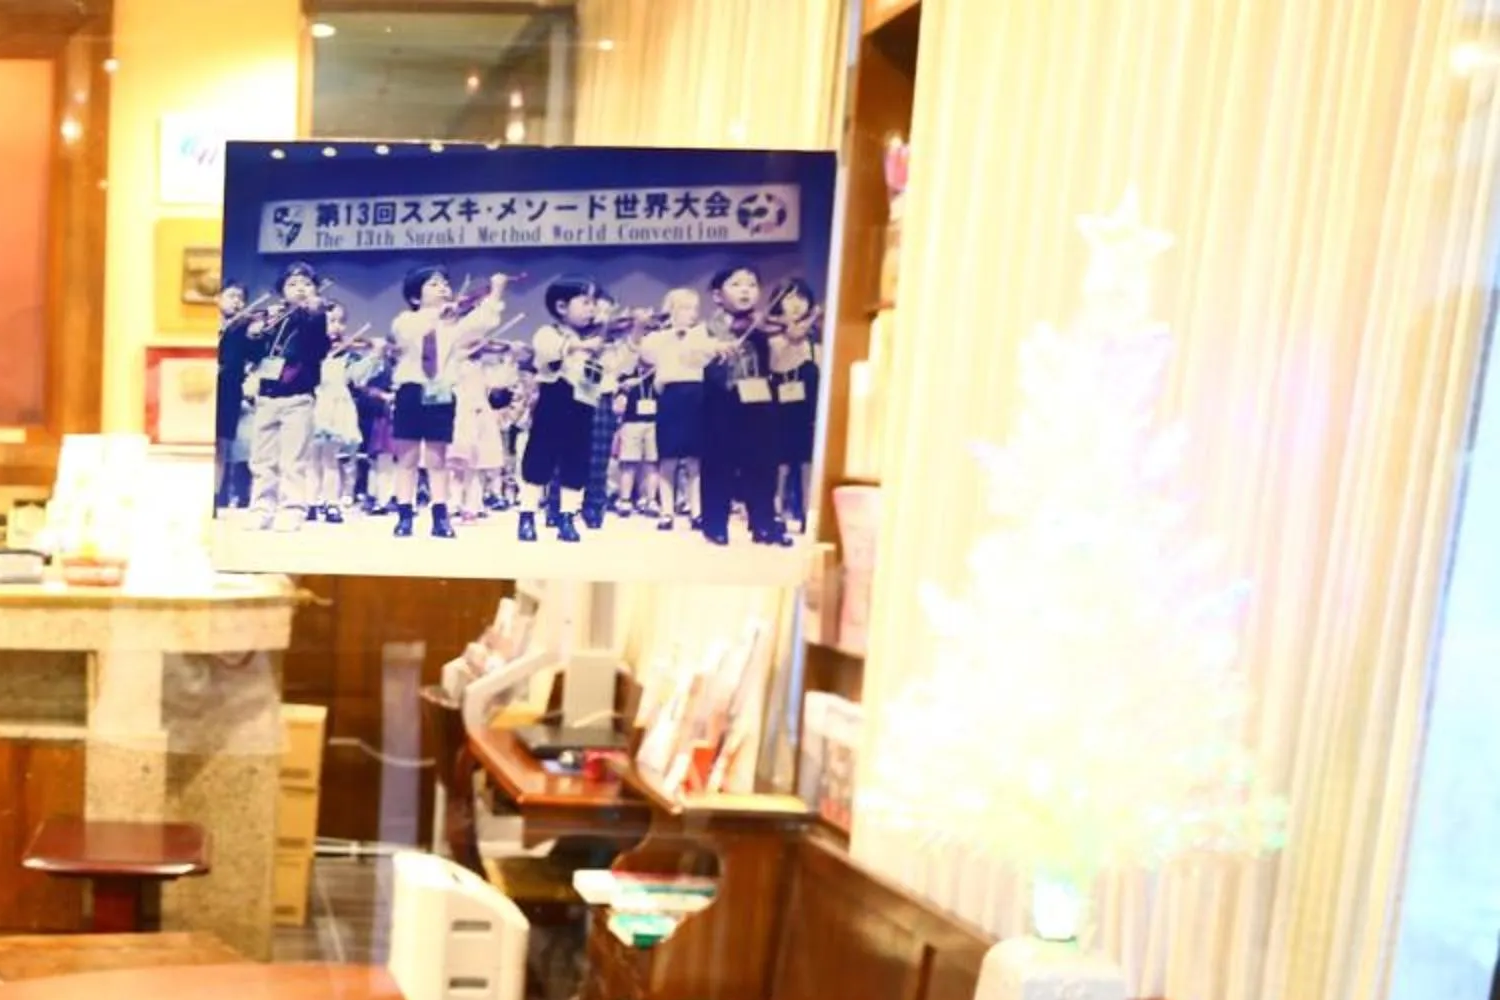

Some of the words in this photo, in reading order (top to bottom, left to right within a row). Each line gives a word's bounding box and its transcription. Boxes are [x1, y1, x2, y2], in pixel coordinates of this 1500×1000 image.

[316, 231, 343, 248] The
[356, 228, 395, 247] 13th
[405, 226, 465, 245] Suzuki
[478, 224, 541, 243] Method
[553, 222, 606, 241] World
[618, 220, 729, 241] Convention
